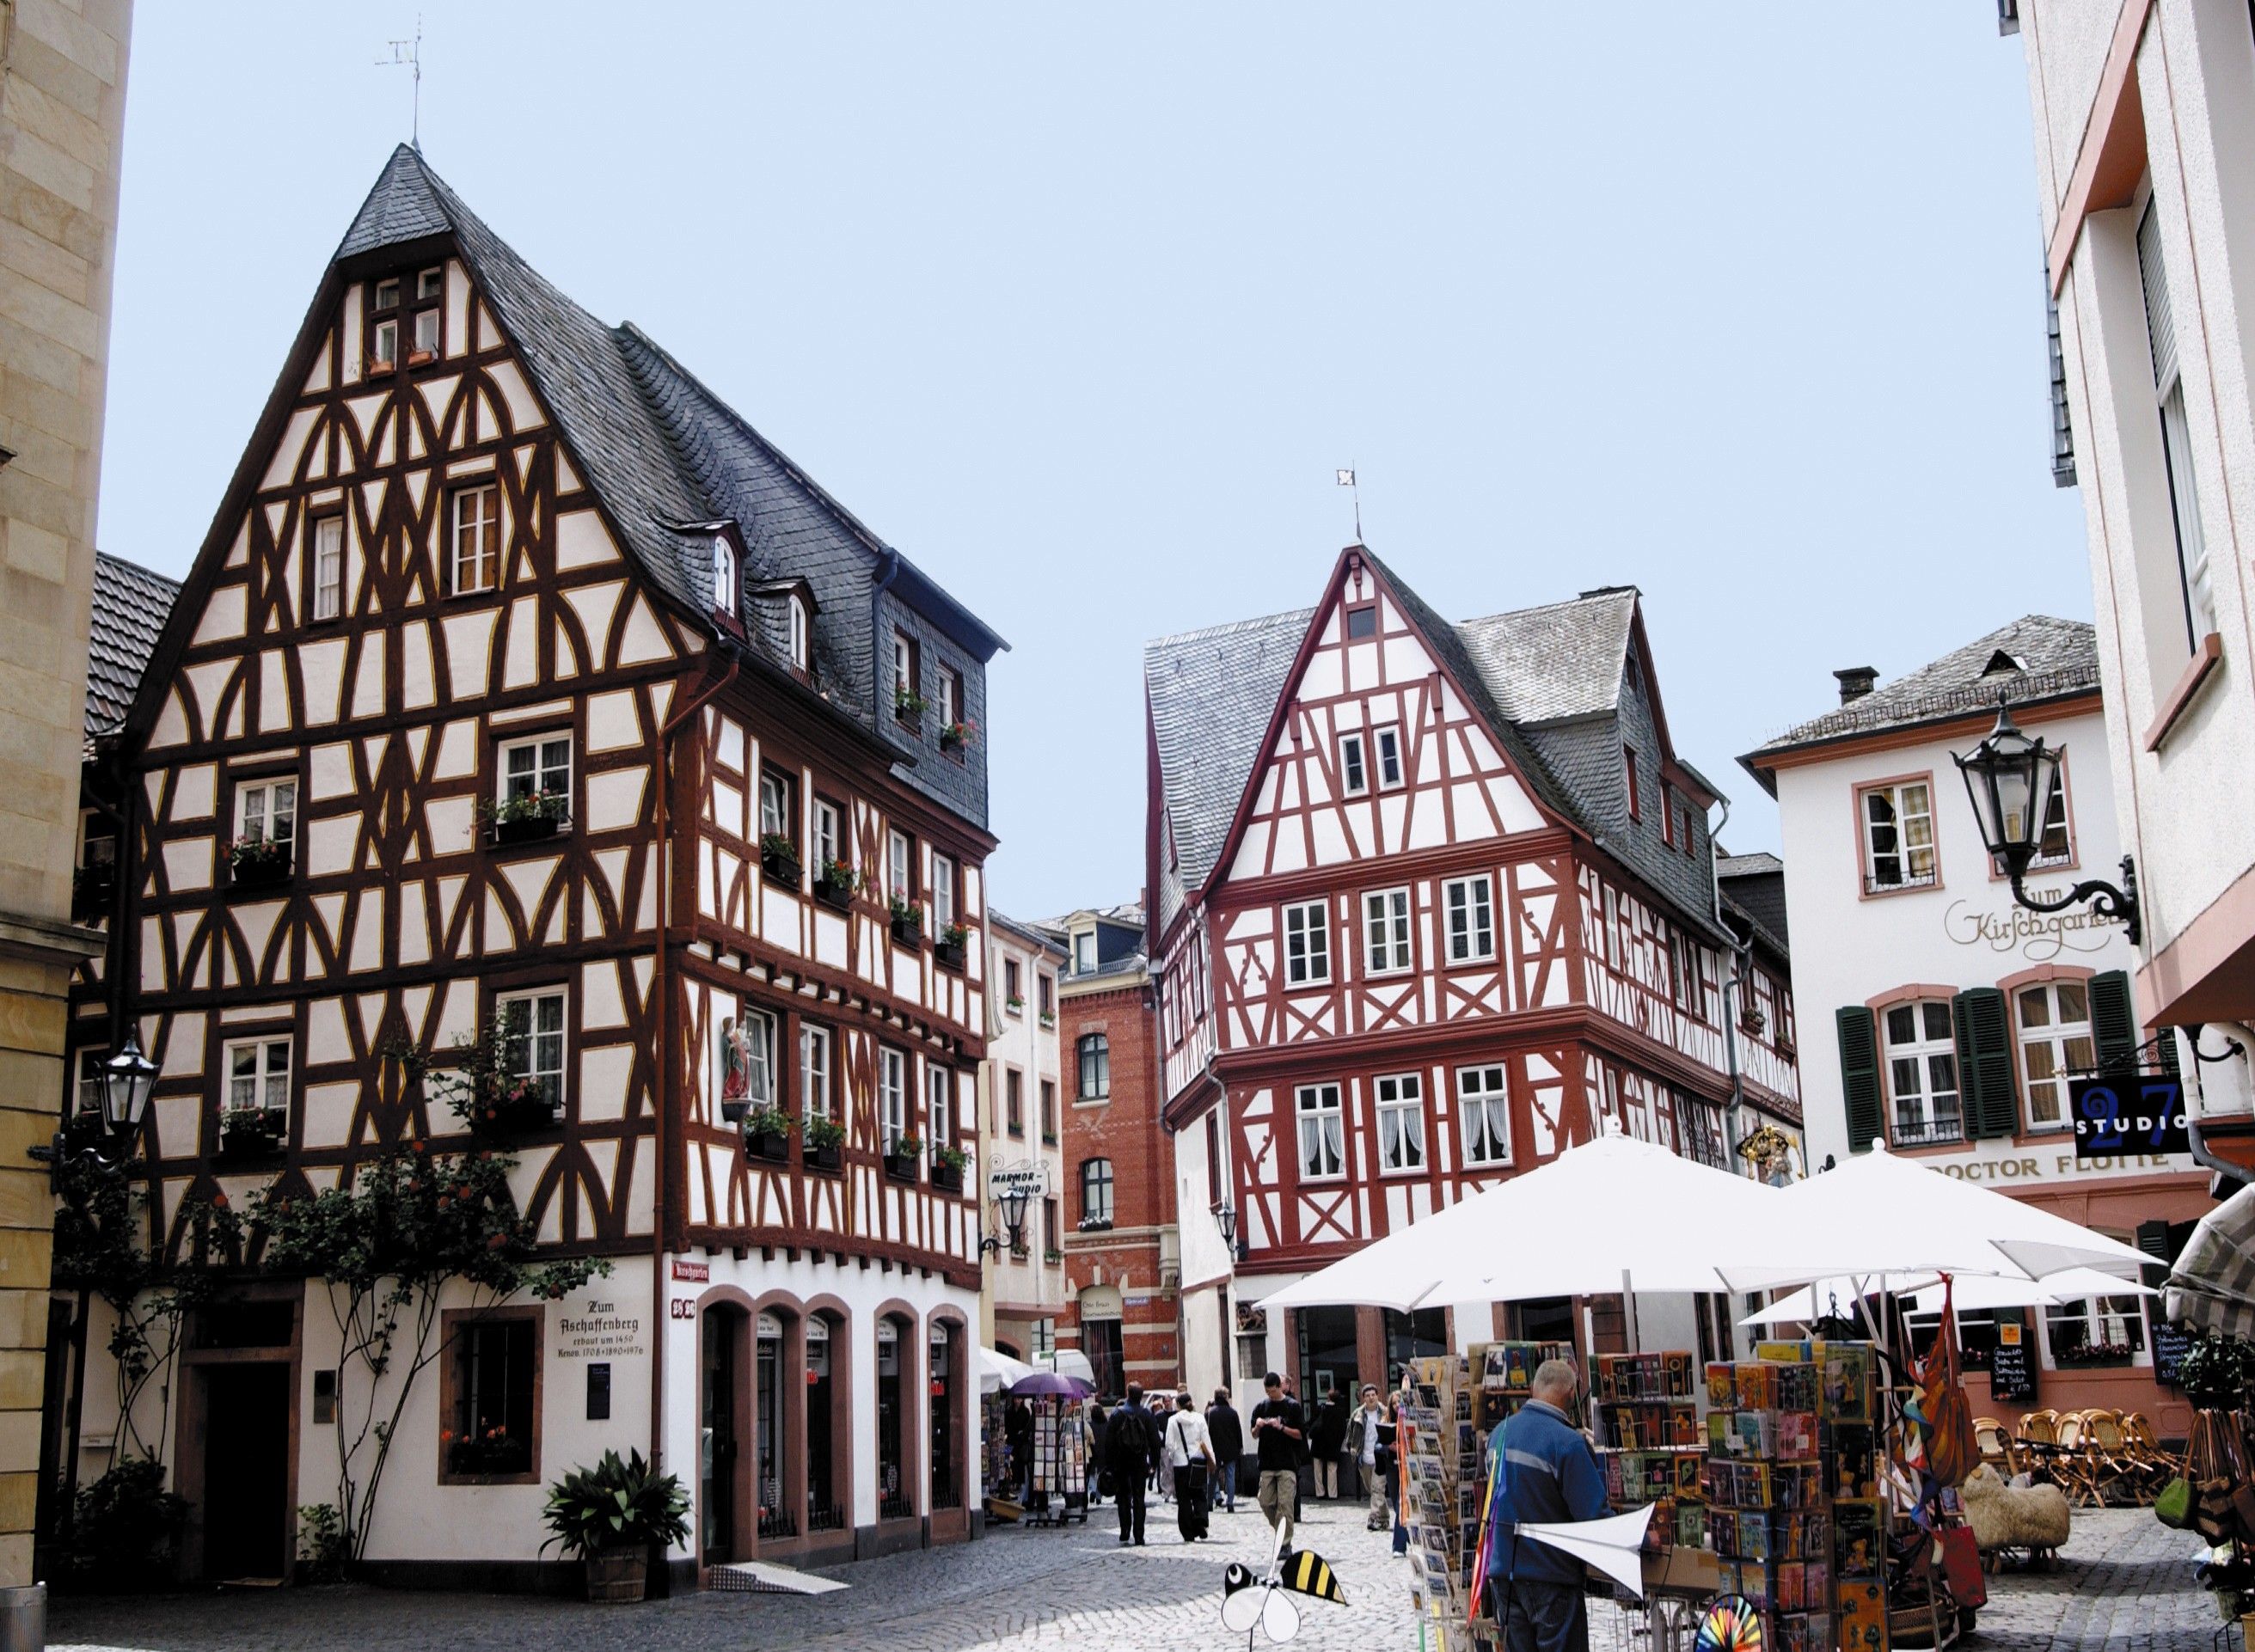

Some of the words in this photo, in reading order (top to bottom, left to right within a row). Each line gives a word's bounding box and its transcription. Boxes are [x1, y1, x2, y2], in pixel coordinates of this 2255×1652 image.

[2076, 1114, 2189, 1135] STUDIO
[587, 1300, 615, 1314] Zum
[560, 1318, 639, 1336] Aschaffenberg
[573, 1337, 598, 1346] erbaut
[600, 1337, 614, 1345] um
